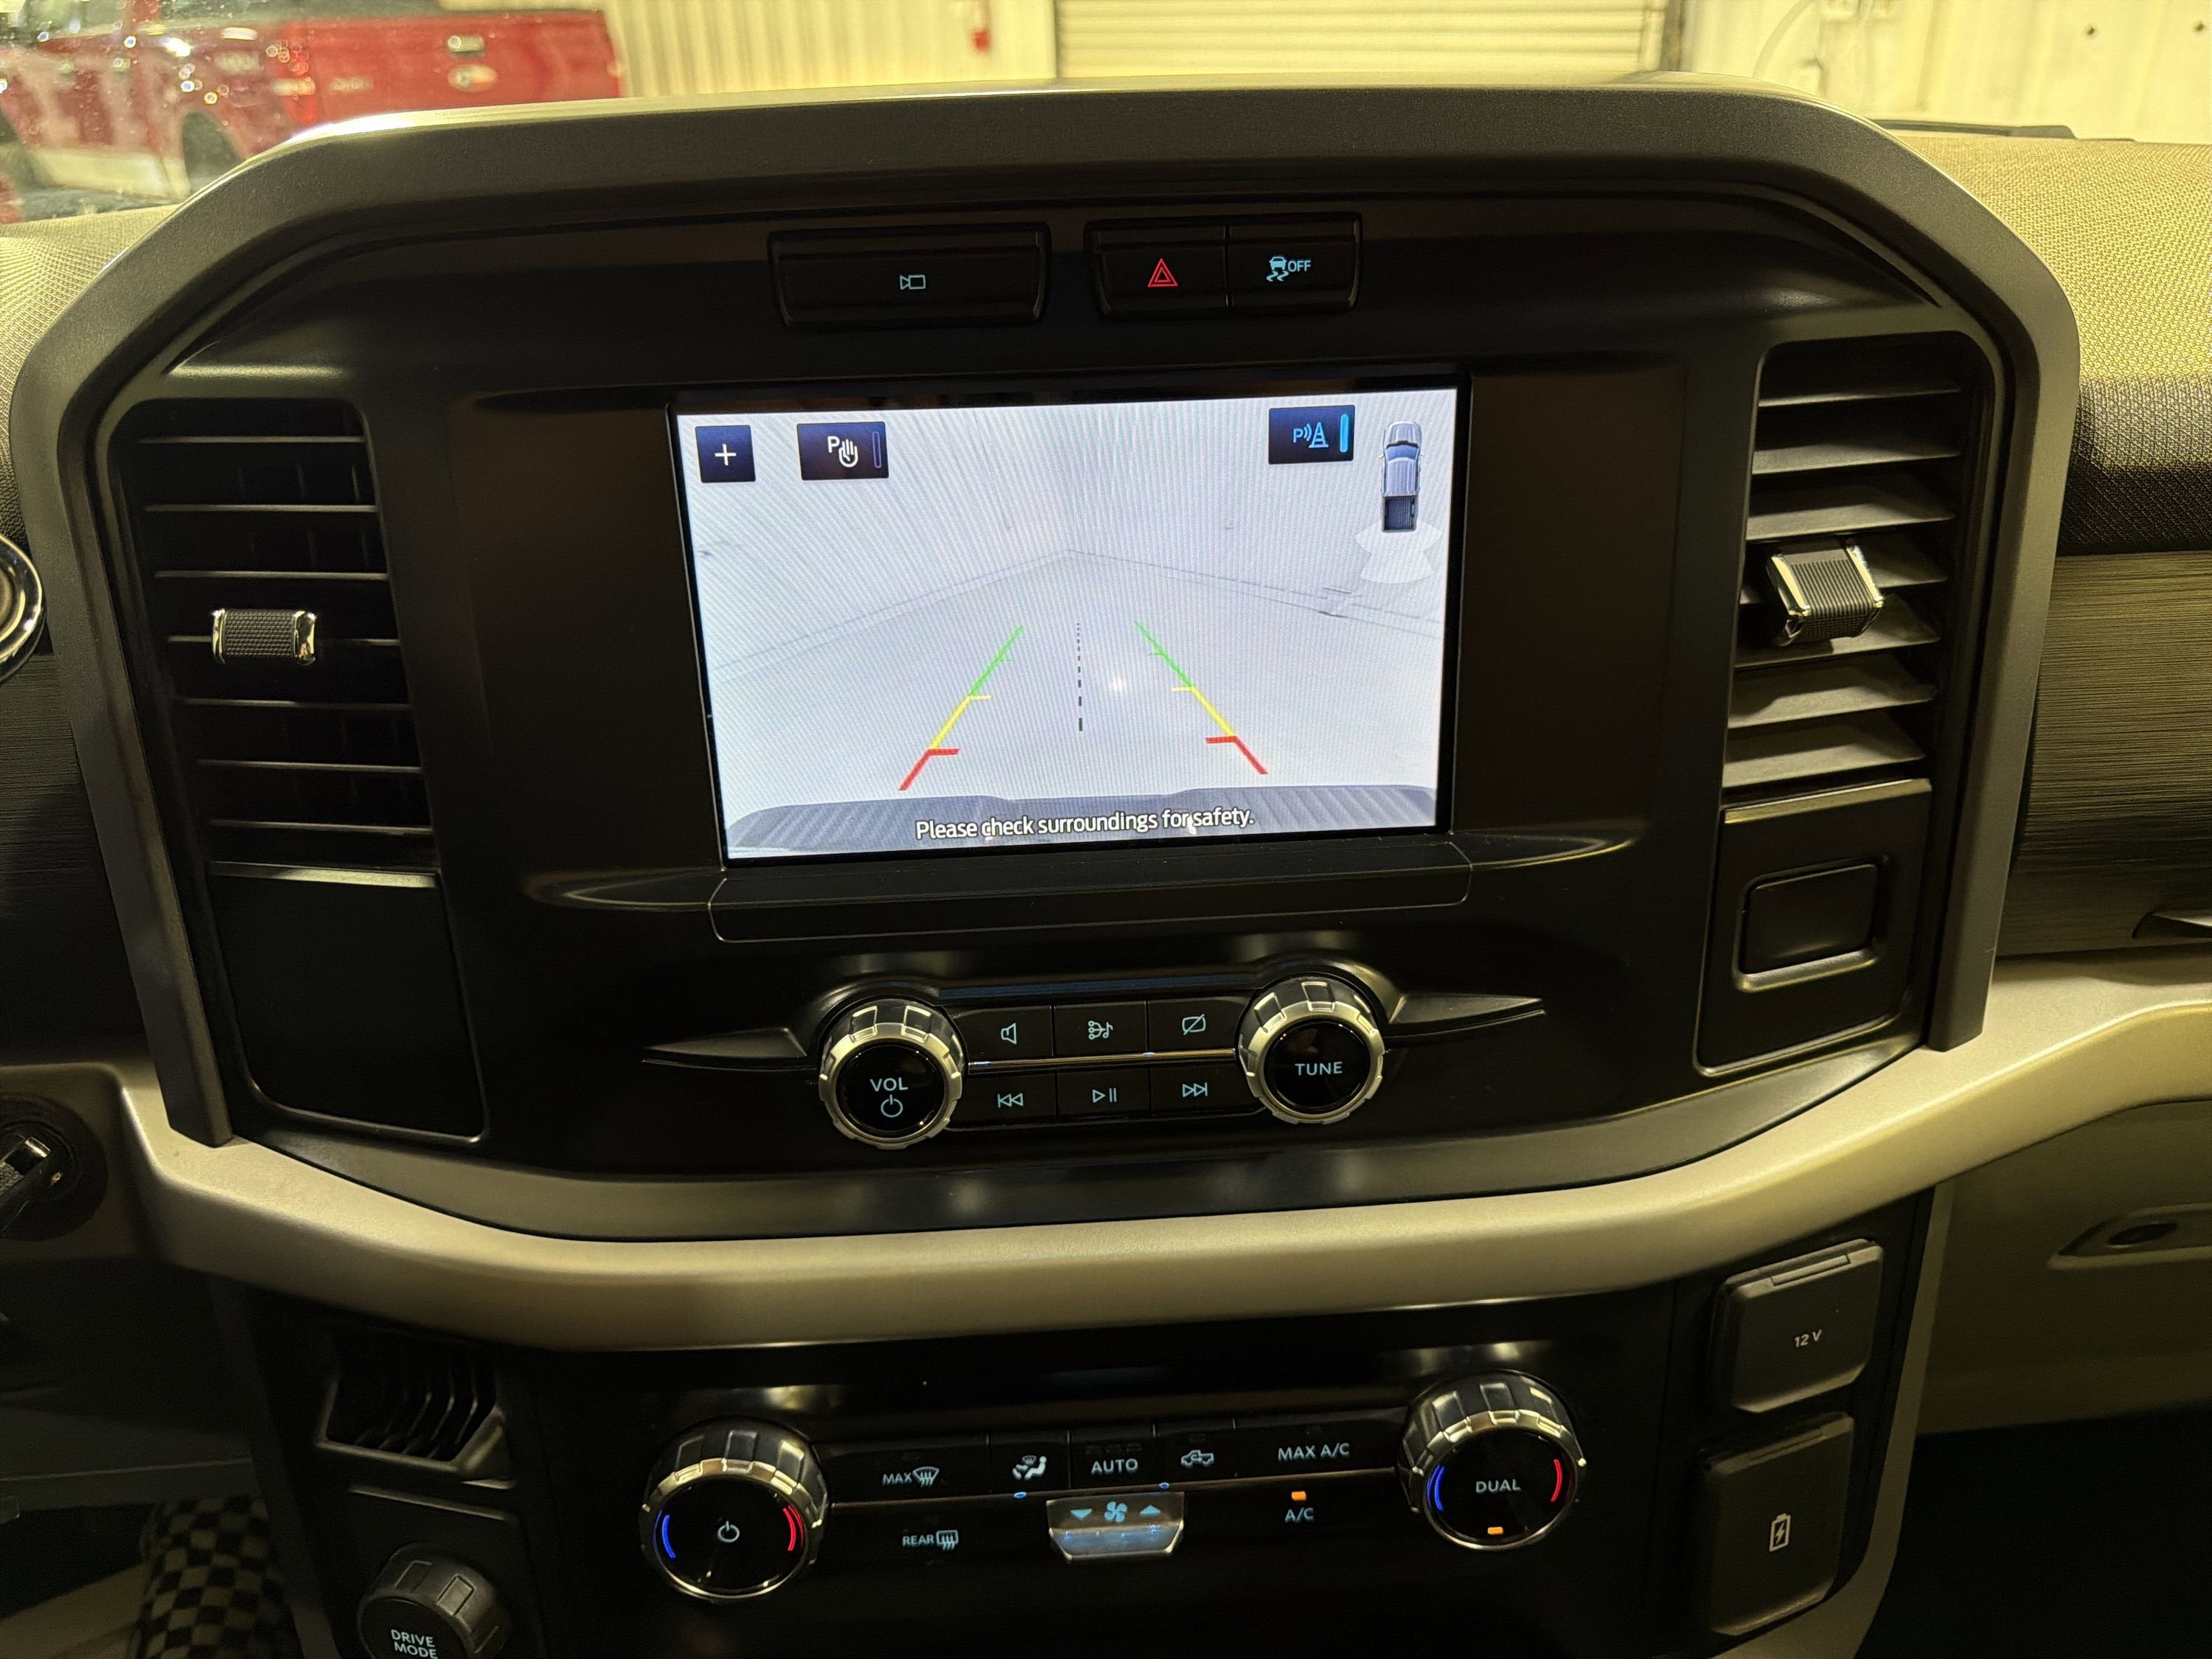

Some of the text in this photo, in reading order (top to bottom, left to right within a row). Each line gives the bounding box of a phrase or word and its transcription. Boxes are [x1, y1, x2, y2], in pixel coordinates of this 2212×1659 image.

[1287, 260, 1312, 273] OFF
[916, 807, 1255, 840] Please check surroundings for safety.
[1295, 1061, 1343, 1077] TUNE
[870, 1077, 909, 1092] VOL
[1794, 1329, 1823, 1348] 12 V
[1278, 1442, 1350, 1461] MAX A/C
[1091, 1457, 1139, 1475] AUTO
[883, 1472, 913, 1485] MAX
[1475, 1478, 1521, 1494] DUAL
[1284, 1506, 1314, 1522] A/C
[902, 1534, 935, 1547] REAR
[390, 1629, 436, 1648] DRIVE
[393, 1641, 439, 1659] MODE
